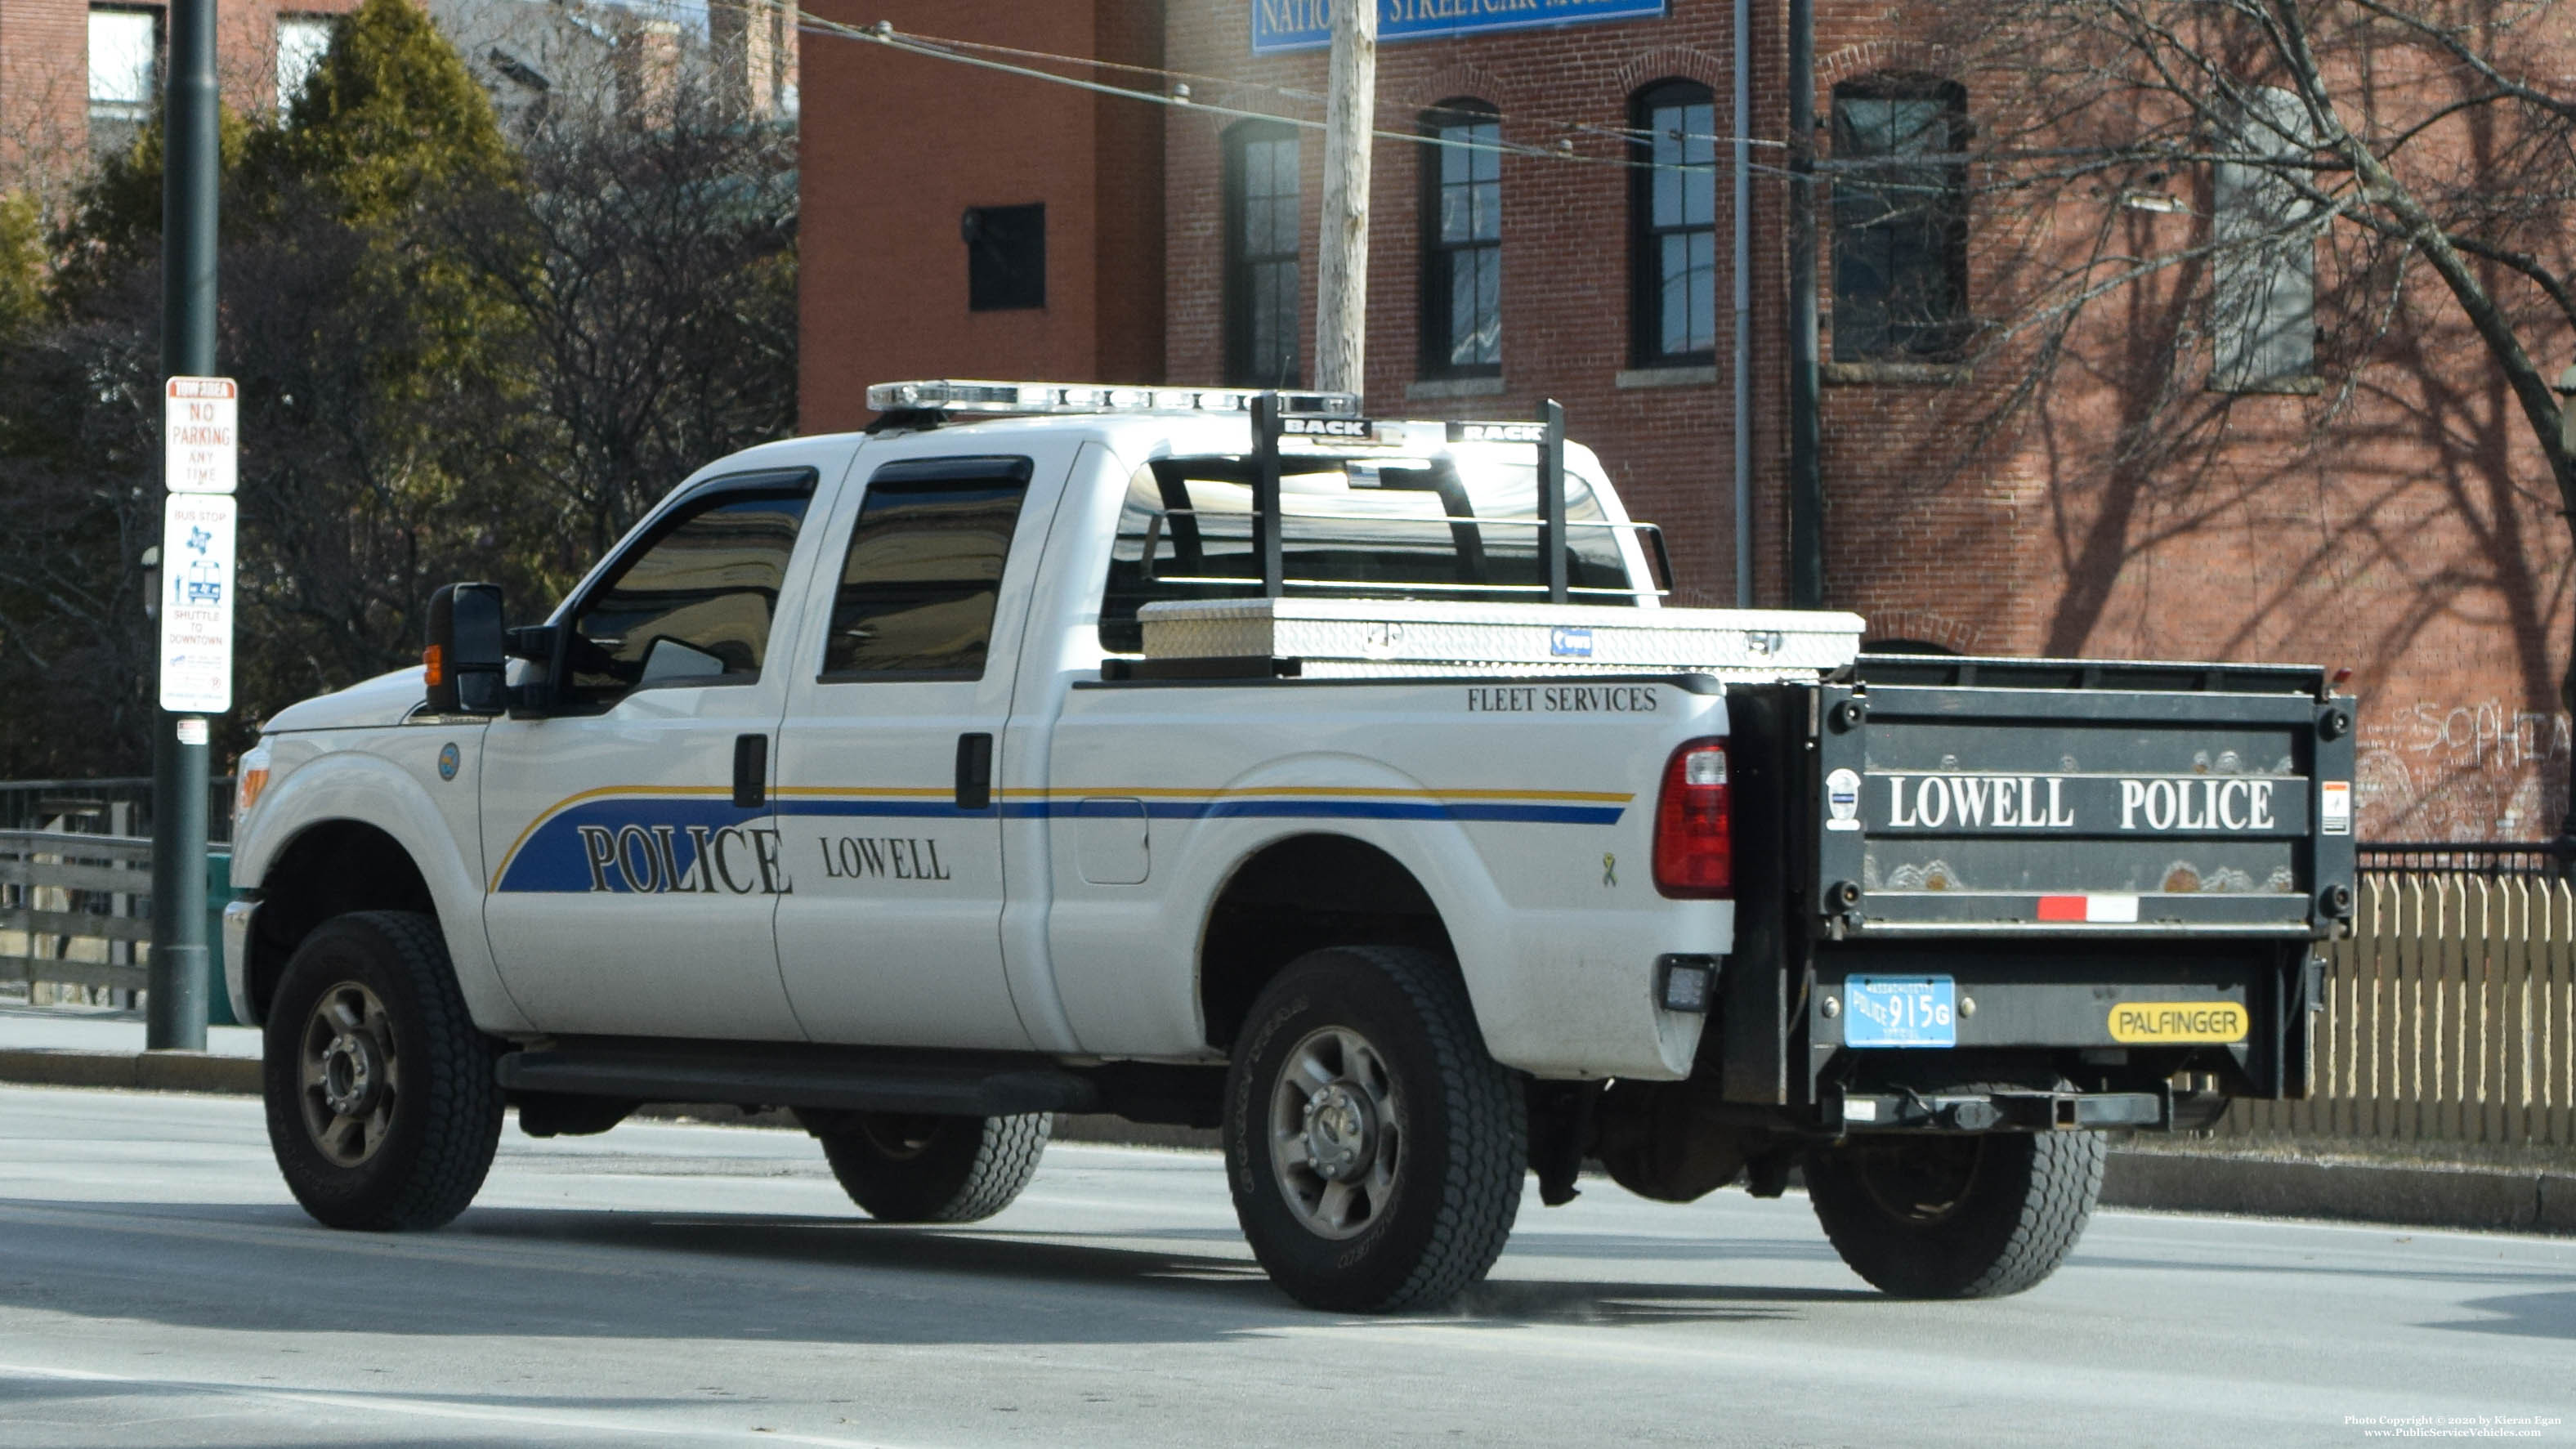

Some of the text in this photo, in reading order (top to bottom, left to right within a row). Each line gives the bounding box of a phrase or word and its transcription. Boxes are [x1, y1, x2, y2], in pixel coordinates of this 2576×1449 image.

[190, 403, 214, 422] NO
[172, 426, 230, 445] PARKING
[1284, 419, 1544, 441] BACK RACK
[189, 451, 213, 464] ANY
[186, 467, 216, 482] TIME
[174, 510, 226, 521] BUS STOP
[173, 610, 220, 622] SHUTTLE
[191, 623, 203, 634] TO
[170, 634, 222, 646] DOWNTOWN
[1468, 687, 1657, 712] FLEET SERVICES
[2408, 698, 2572, 768] SOPHIA
[1888, 776, 2275, 830] LOWELL POLICE
[579, 825, 950, 894] POLICE LOWELL
[2118, 1010, 2238, 1034] PALFINGER
